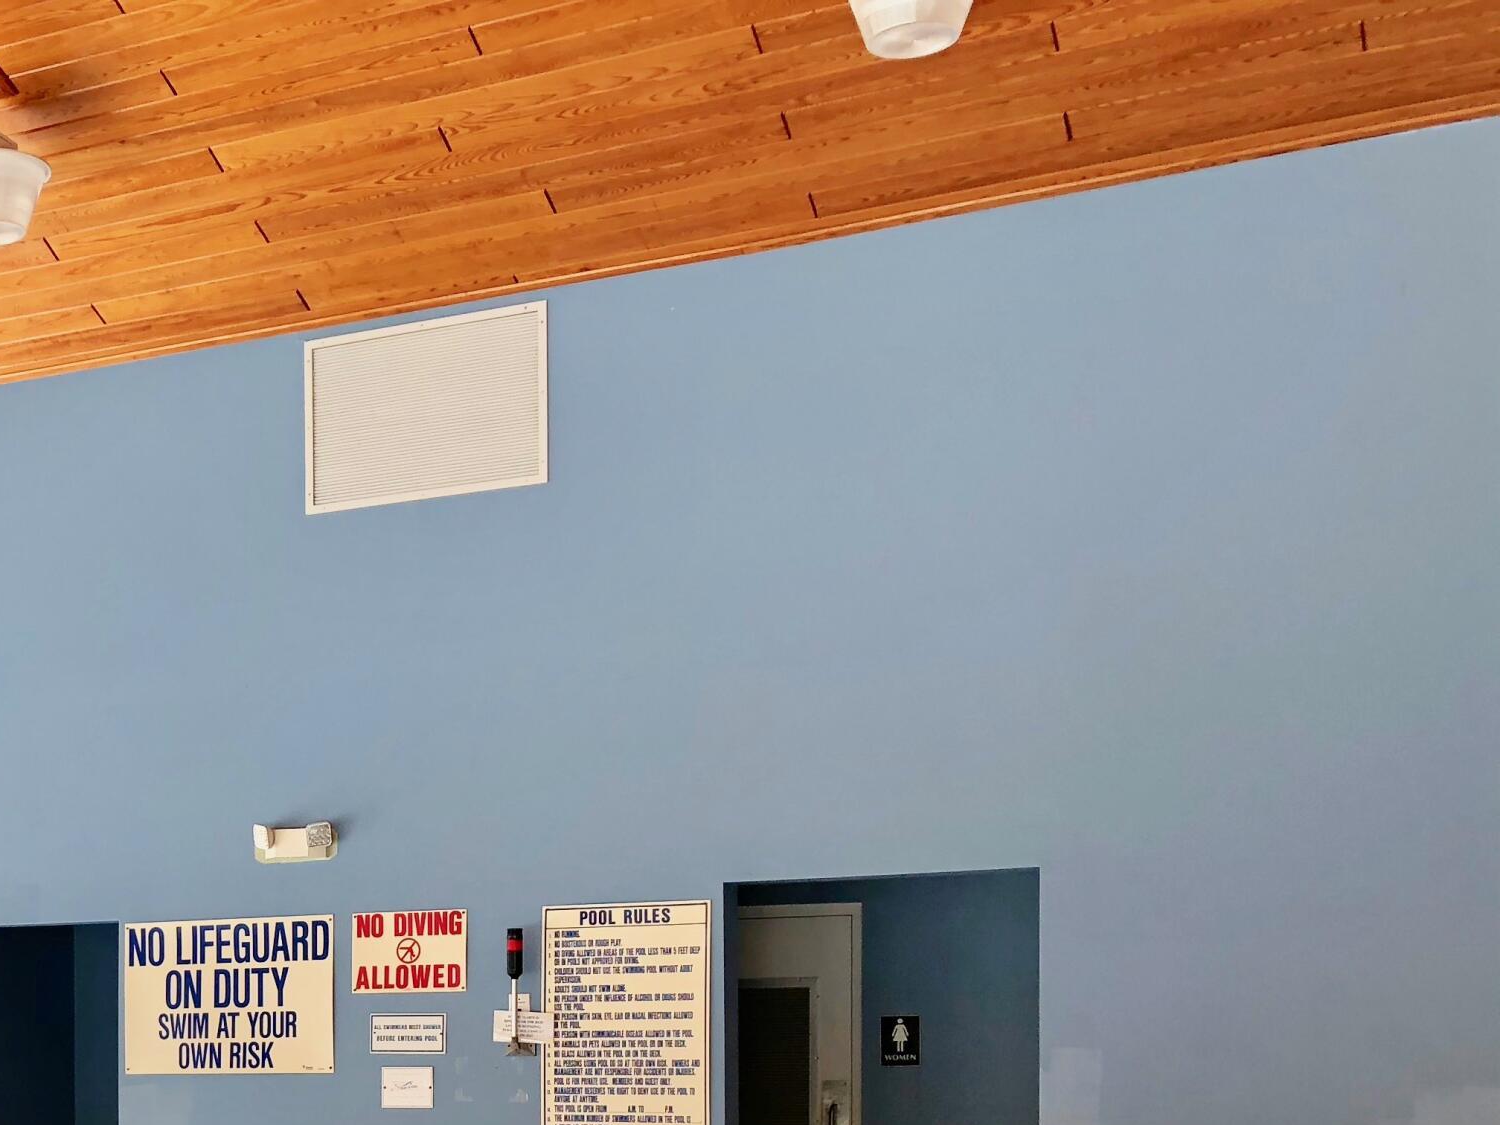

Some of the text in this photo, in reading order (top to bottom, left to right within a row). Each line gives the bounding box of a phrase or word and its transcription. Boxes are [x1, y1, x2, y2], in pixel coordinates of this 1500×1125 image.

[356, 910, 462, 938] NO DIVING
[579, 908, 671, 926] POOL RULES
[128, 920, 329, 966] NO LIFEGUARD
[165, 967, 289, 1009] ON DUTY
[356, 963, 461, 990] ALLOWED
[158, 1010, 297, 1040] SWIM AT YOUR
[178, 1041, 274, 1070] OWN RISK
